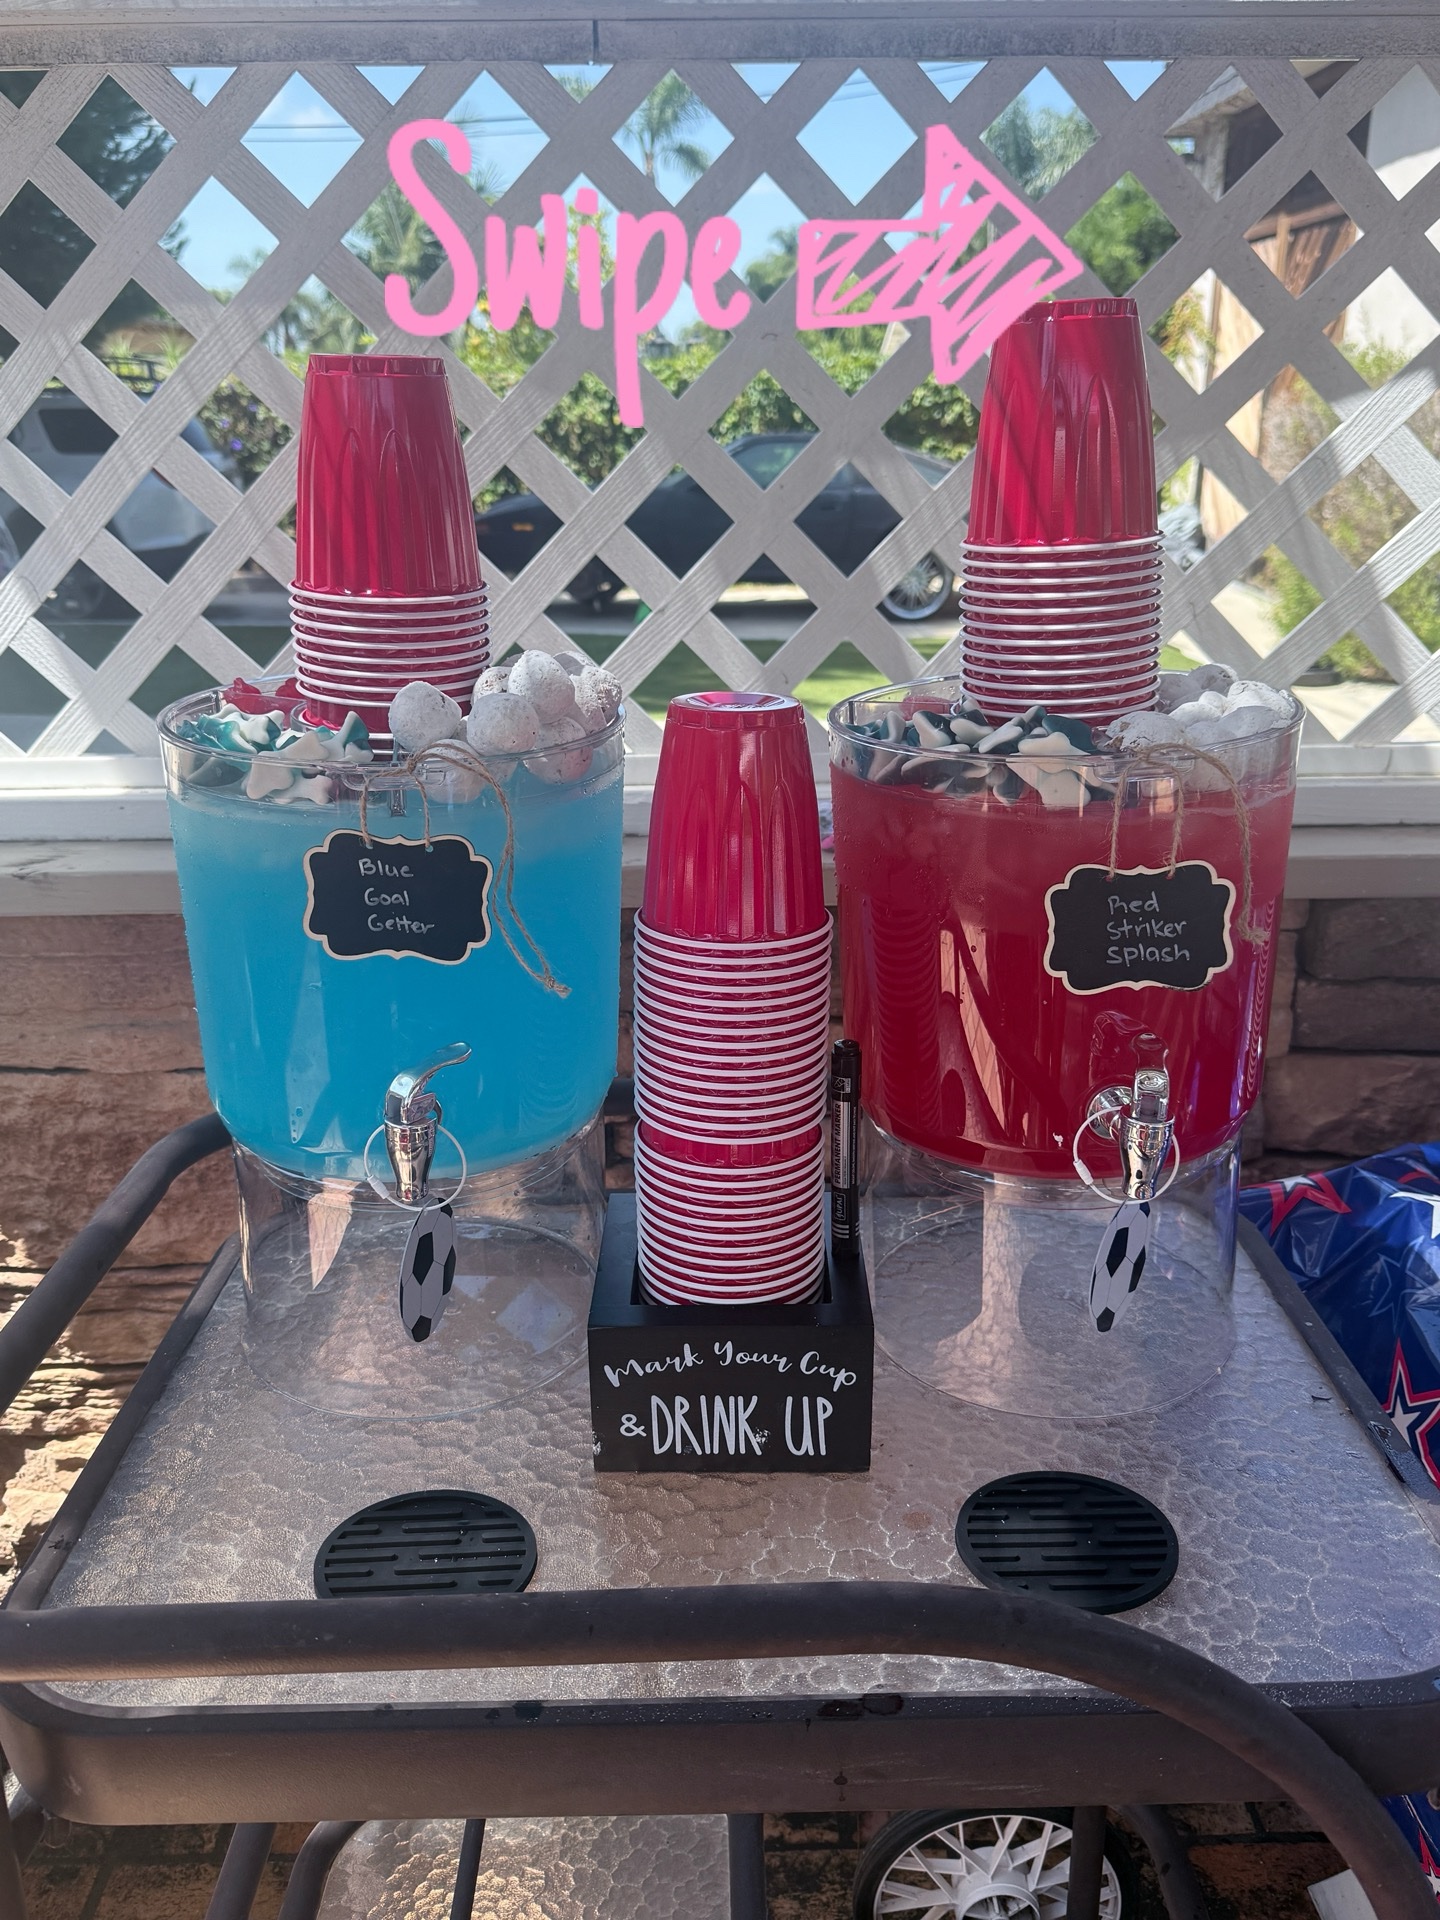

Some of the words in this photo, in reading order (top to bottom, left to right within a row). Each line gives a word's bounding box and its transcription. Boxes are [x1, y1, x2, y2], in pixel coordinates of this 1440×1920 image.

[358, 858, 414, 877] Blue
[364, 887, 410, 906] Goal
[1108, 891, 1160, 915] Red
[834, 1139, 842, 1184] PERMANENT
[603, 1343, 703, 1388] Mark
[713, 1340, 792, 1373] Your
[800, 1350, 857, 1392] Cup
[619, 1413, 647, 1437] &
[651, 1394, 762, 1456] DRINK
[784, 1395, 834, 1456] UP
